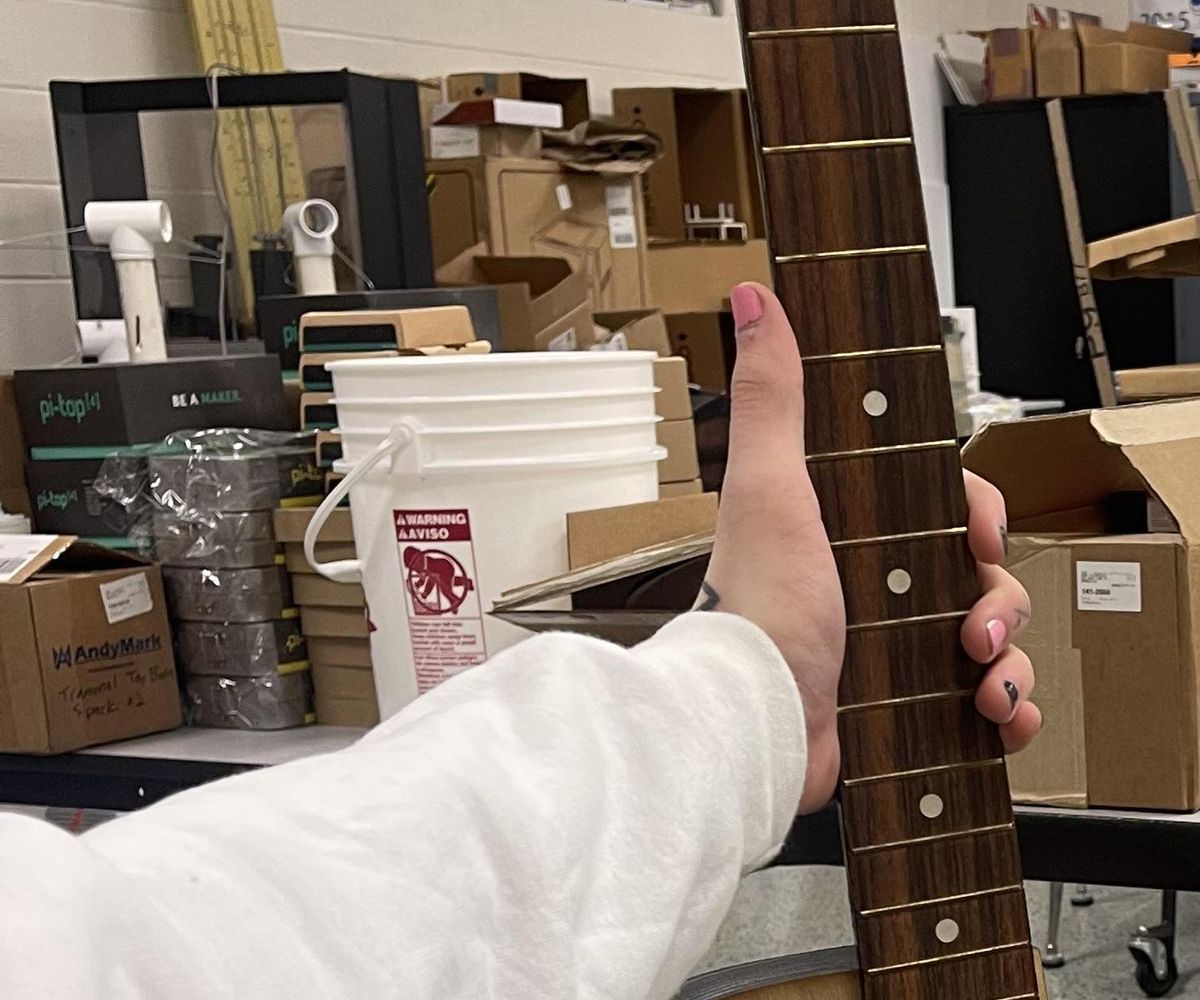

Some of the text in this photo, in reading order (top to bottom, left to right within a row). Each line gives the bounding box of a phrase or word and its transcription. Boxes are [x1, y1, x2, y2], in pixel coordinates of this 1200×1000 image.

[171, 393, 187, 408] BE
[190, 392, 200, 407] A
[405, 513, 467, 526] WARNING
[408, 527, 449, 540] AVISO
[74, 633, 162, 663] AndyMark
